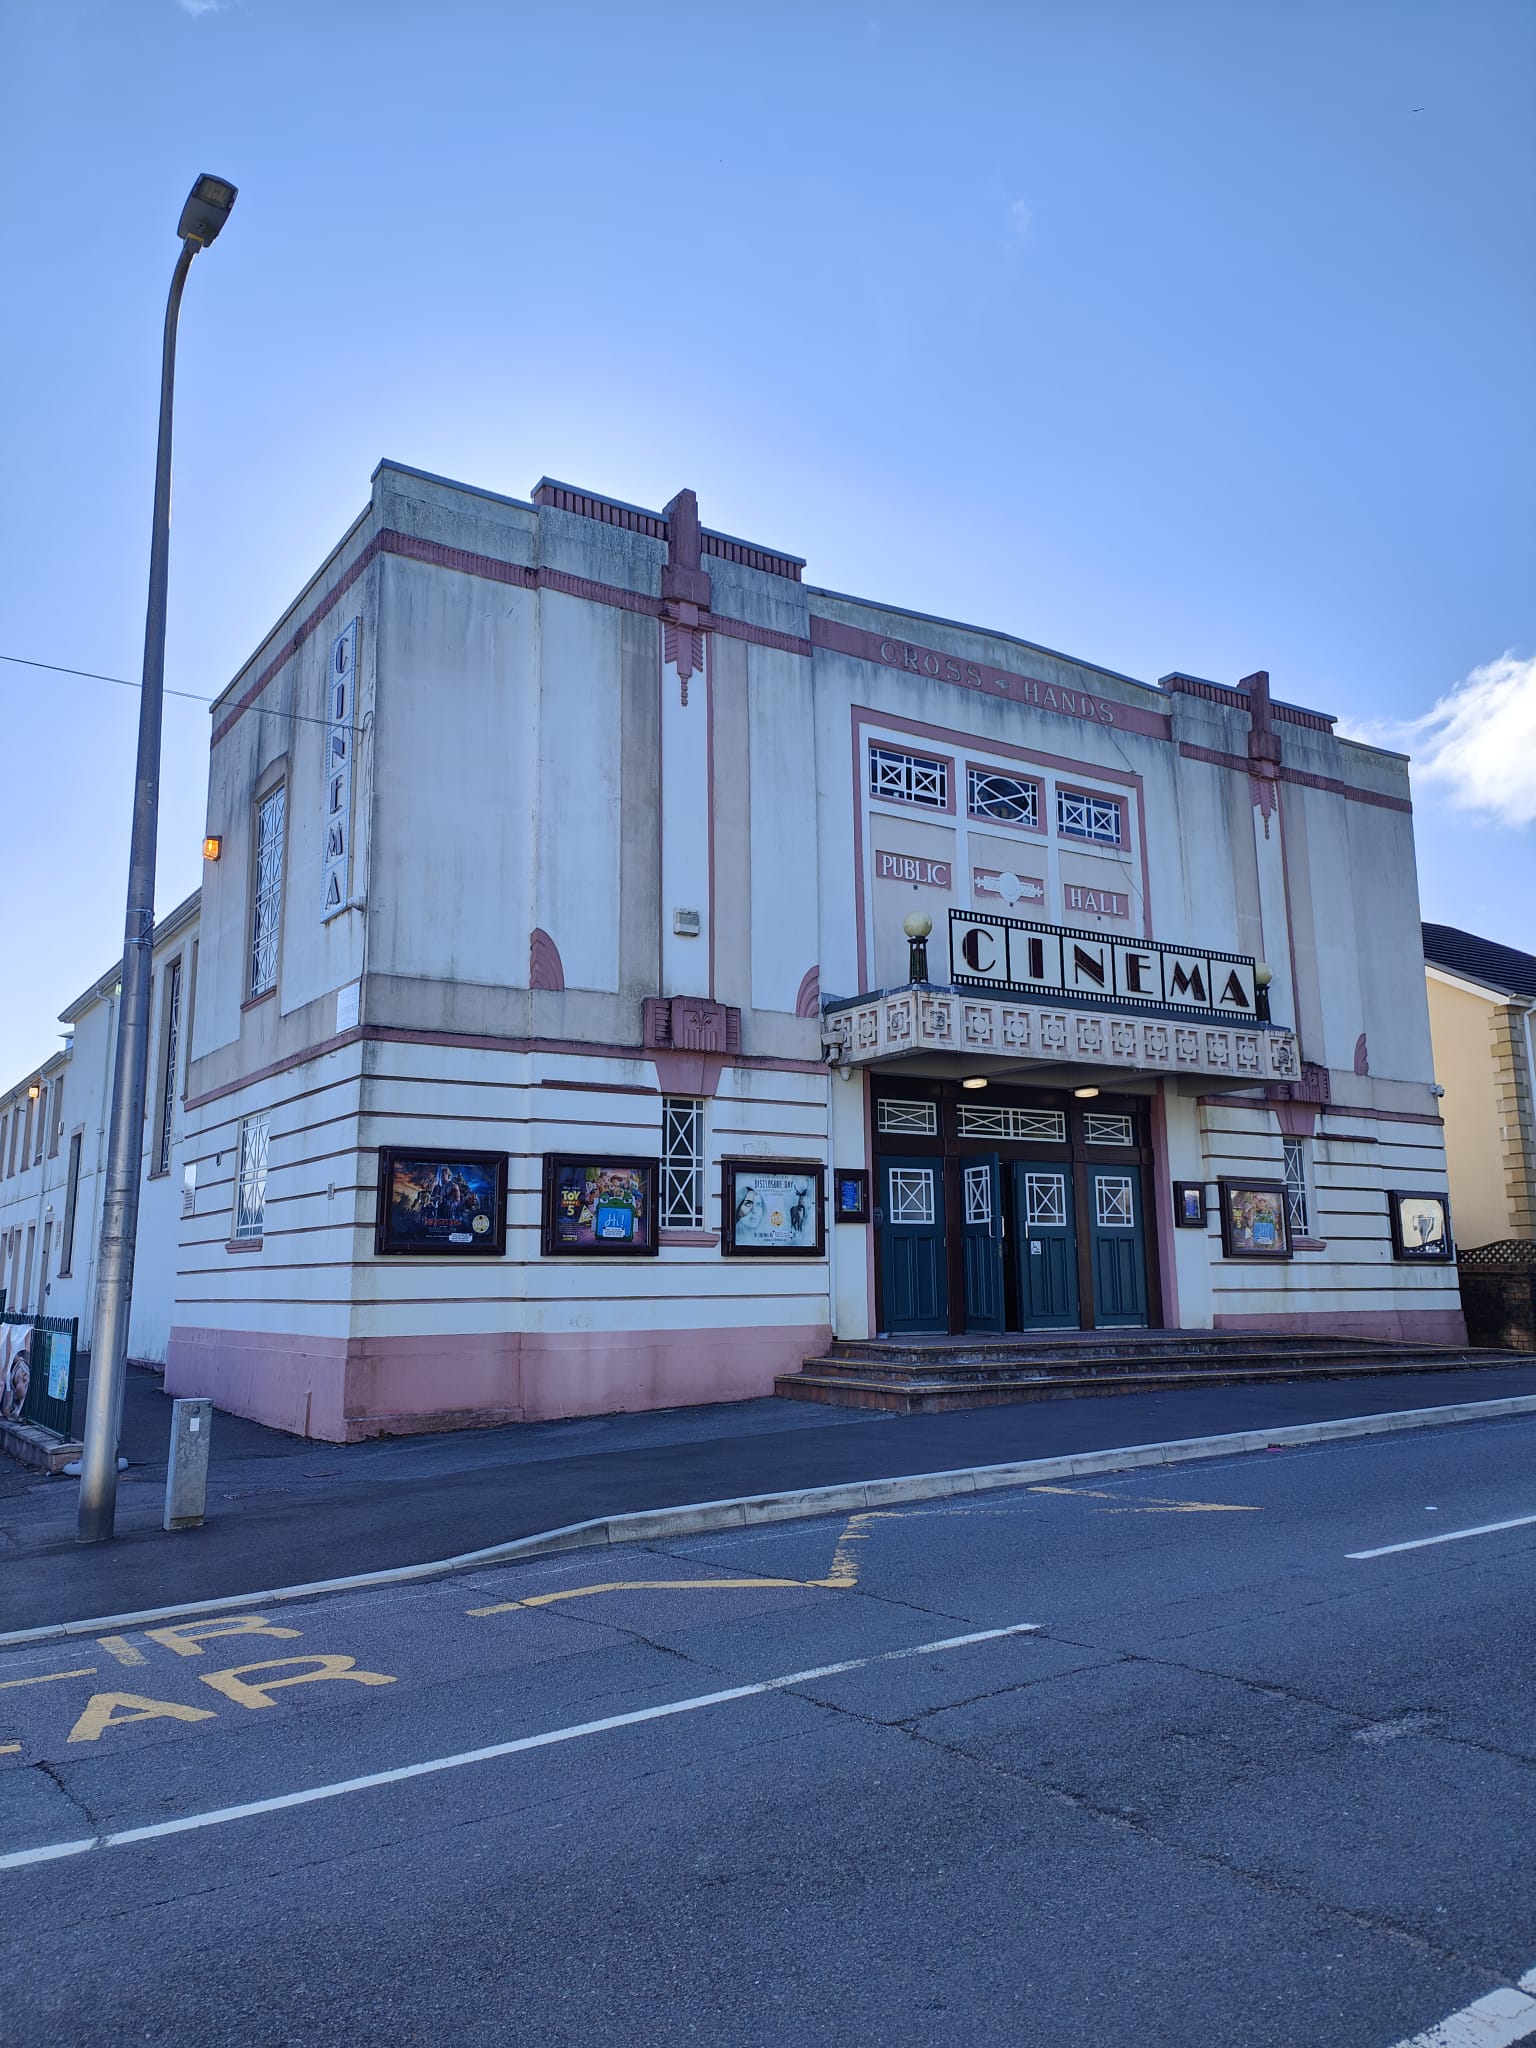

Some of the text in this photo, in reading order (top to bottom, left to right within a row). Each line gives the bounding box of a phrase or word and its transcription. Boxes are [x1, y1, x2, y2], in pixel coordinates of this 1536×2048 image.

[880, 641, 1115, 724] CROSS HANDS
[881, 854, 948, 886] PUBLIC
[1070, 888, 1124, 916] HALL
[962, 927, 1250, 1008] CINEMA
[561, 1190, 581, 1201] TOY
[567, 1205, 575, 1216] 5
